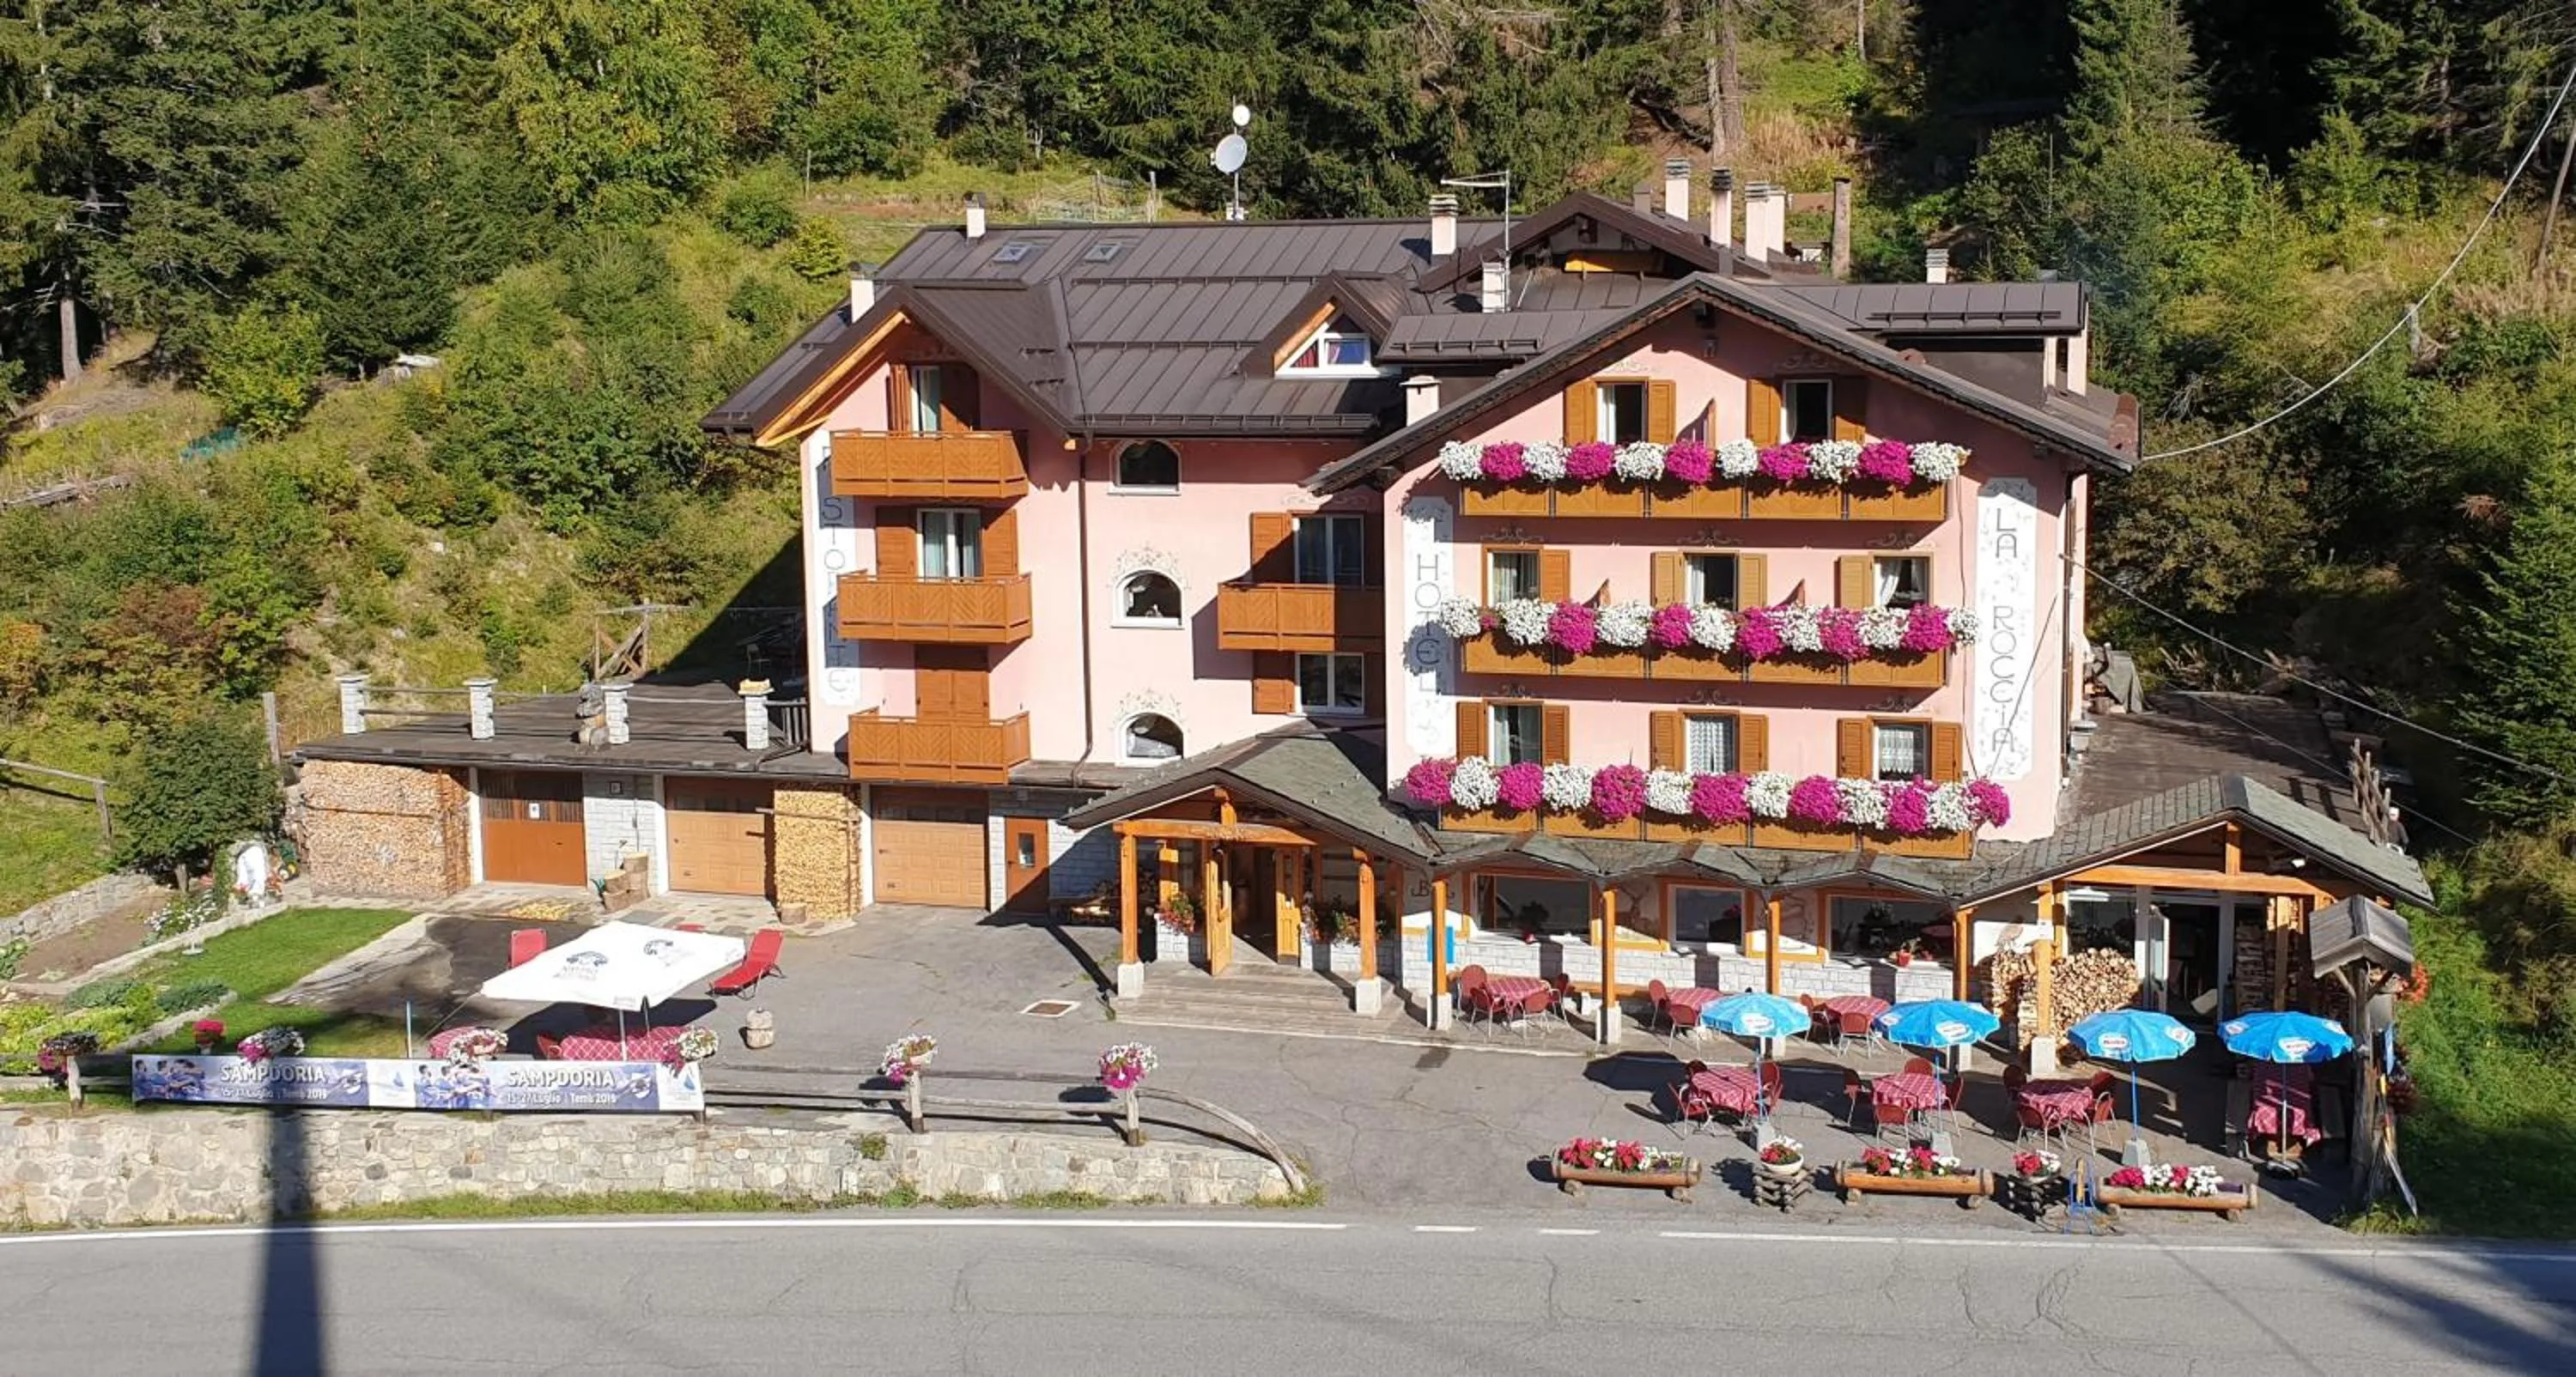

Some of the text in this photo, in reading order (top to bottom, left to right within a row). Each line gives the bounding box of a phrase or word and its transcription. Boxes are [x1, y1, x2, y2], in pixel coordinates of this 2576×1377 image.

[821, 446, 852, 693] STOTE
[1414, 553, 1442, 693] HOTEL
[1990, 507, 2018, 753] LA ROCCIA
[220, 1064, 328, 1083] SAMPDORIA
[507, 1069, 616, 1088] SAMPDORIA
